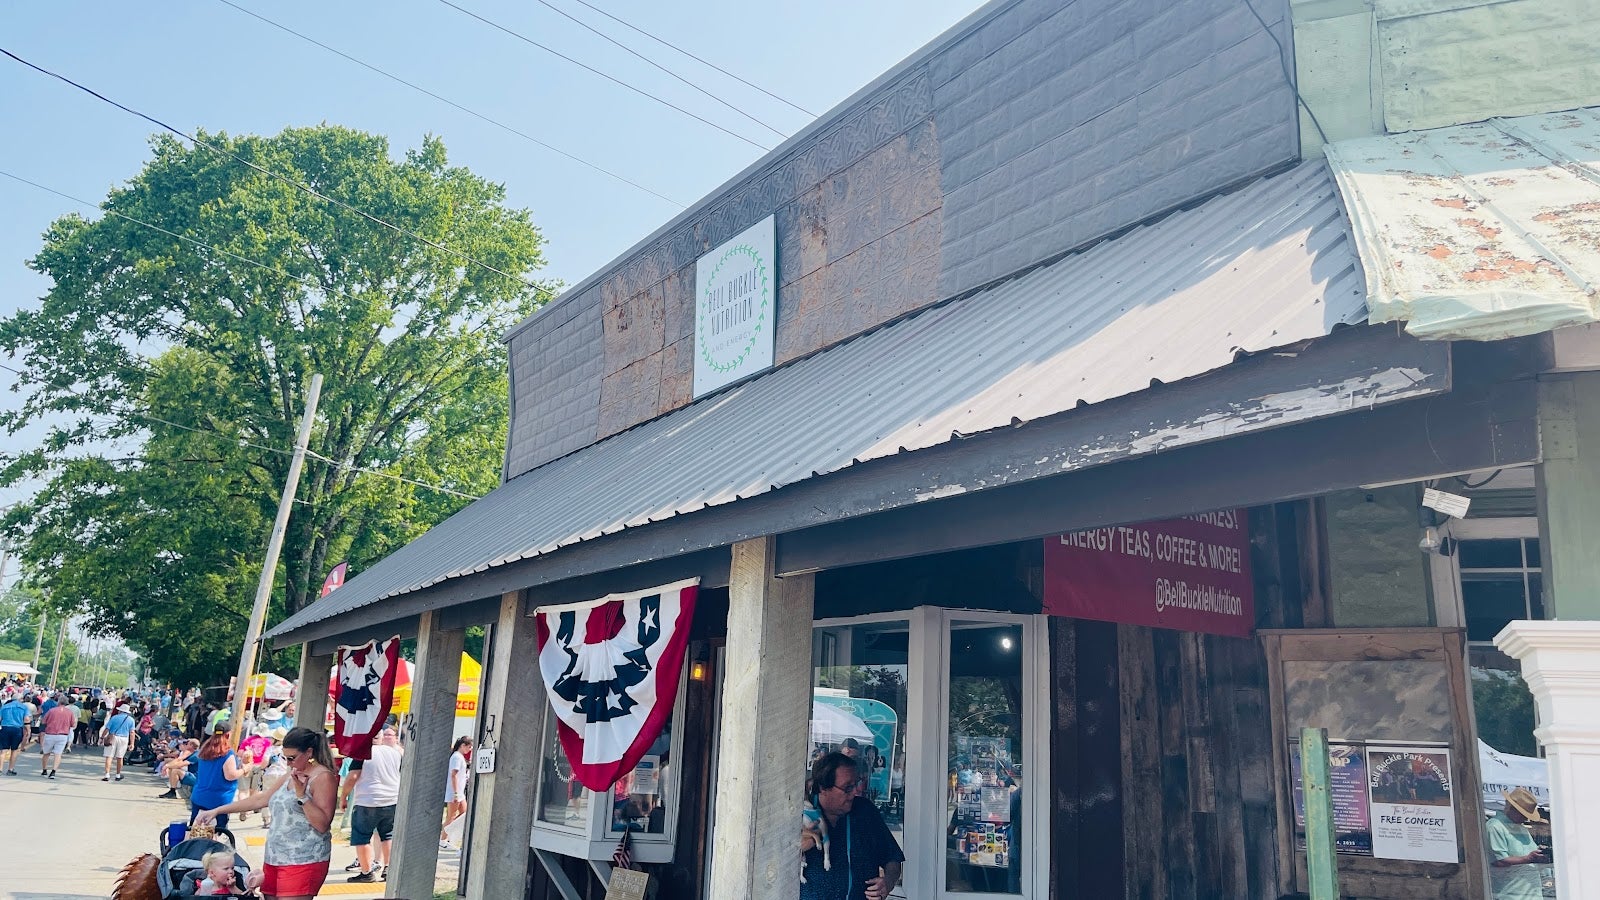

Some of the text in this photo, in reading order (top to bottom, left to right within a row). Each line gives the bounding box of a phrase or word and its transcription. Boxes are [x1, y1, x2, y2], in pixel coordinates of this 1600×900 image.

[708, 268, 757, 314] BELL BUCKLE
[711, 297, 753, 337] NUTRITION
[1117, 527, 1154, 563] TEAS,
[1156, 533, 1197, 566] COFFEE
[1199, 542, 1208, 568] &
[1208, 544, 1242, 574] MORE!
[1155, 577, 1243, 616] @BellBuckleNutrition
[479, 756, 491, 769] OPEN
[1371, 752, 1450, 791] Bell Buckle Park Presents
[1380, 815, 1445, 826] FREE CONCERT
